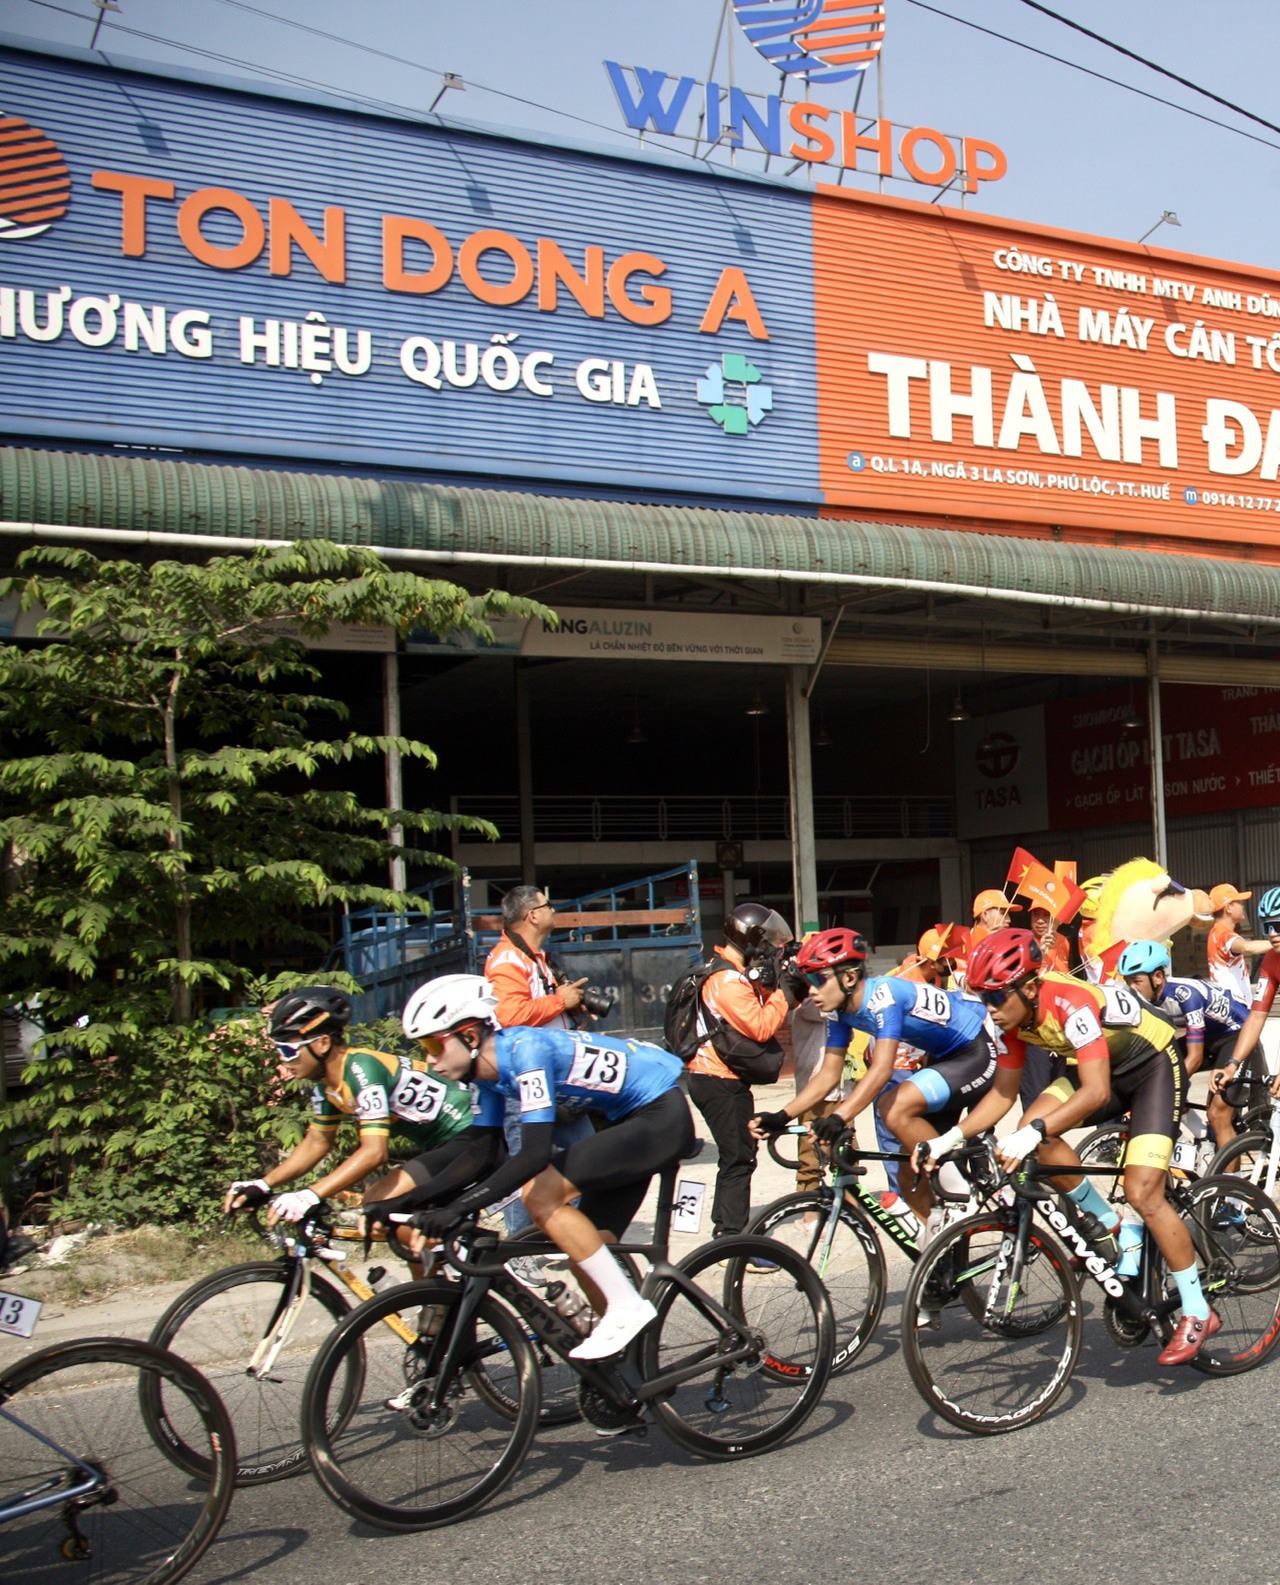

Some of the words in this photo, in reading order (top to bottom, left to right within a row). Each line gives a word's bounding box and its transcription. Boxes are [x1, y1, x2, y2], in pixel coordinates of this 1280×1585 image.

[603, 60, 1007, 194] WINSHOP
[91, 171, 348, 284] TON
[383, 214, 674, 327] DONG
[698, 267, 771, 342] A
[993, 247, 1053, 277] CÔNG
[1057, 260, 1085, 282] TY
[1092, 266, 1147, 294] TNHH
[1153, 277, 1196, 303] MTV
[1202, 287, 1242, 312] ANH
[983, 291, 1066, 338] NHÀ
[1078, 307, 1155, 351] MÁY
[1164, 320, 1236, 365] CÁN
[240, 310, 371, 387] HIỆU
[400, 332, 554, 398] QUỐC
[576, 358, 663, 408] GIA
[867, 352, 1179, 469] THÀNH
[870, 455, 898, 474] Q.L
[902, 460, 928, 477] 1A,
[931, 460, 967, 480] NGÃ
[970, 467, 980, 481] 3
[983, 468, 1003, 484] LA
[1007, 468, 1044, 489] SƠN,
[1047, 472, 1079, 491] PHÚ
[1082, 474, 1115, 497] LỘC,
[1202, 491, 1235, 508] 0914
[1238, 494, 1254, 509] 12
[1256, 497, 1272, 511] 77
[590, 641, 601, 650] LÁ
[627, 641, 652, 652] NHIỆT
[653, 642, 665, 653] ĐỘ
[667, 642, 683, 653] BỀN
[685, 643, 708, 654] VỮNG
[709, 644, 724, 654] VỚI
[725, 644, 743, 655] THỜI
[744, 646, 764, 656] GIAN
[1070, 744, 1115, 782] GẠCH
[1116, 730, 1140, 768] ỐP
[1142, 733, 1174, 765] LT
[1175, 727, 1222, 759] TASA
[974, 786, 1022, 811] TASA
[1074, 790, 1104, 811] GẠCH
[1106, 784, 1122, 805] ỐP
[1125, 785, 1144, 803] LÁT
[1192, 774, 1227, 794] NƯỚC
[922, 987, 946, 1016] 16
[1115, 989, 1132, 1015] 6
[1075, 1017, 1088, 1035] 6
[584, 1046, 619, 1084] 73
[398, 1077, 440, 1114] 55
[522, 1077, 545, 1101] 73
[678, 1195, 698, 1217] 73
[1037, 1199, 1126, 1299] cervélo
